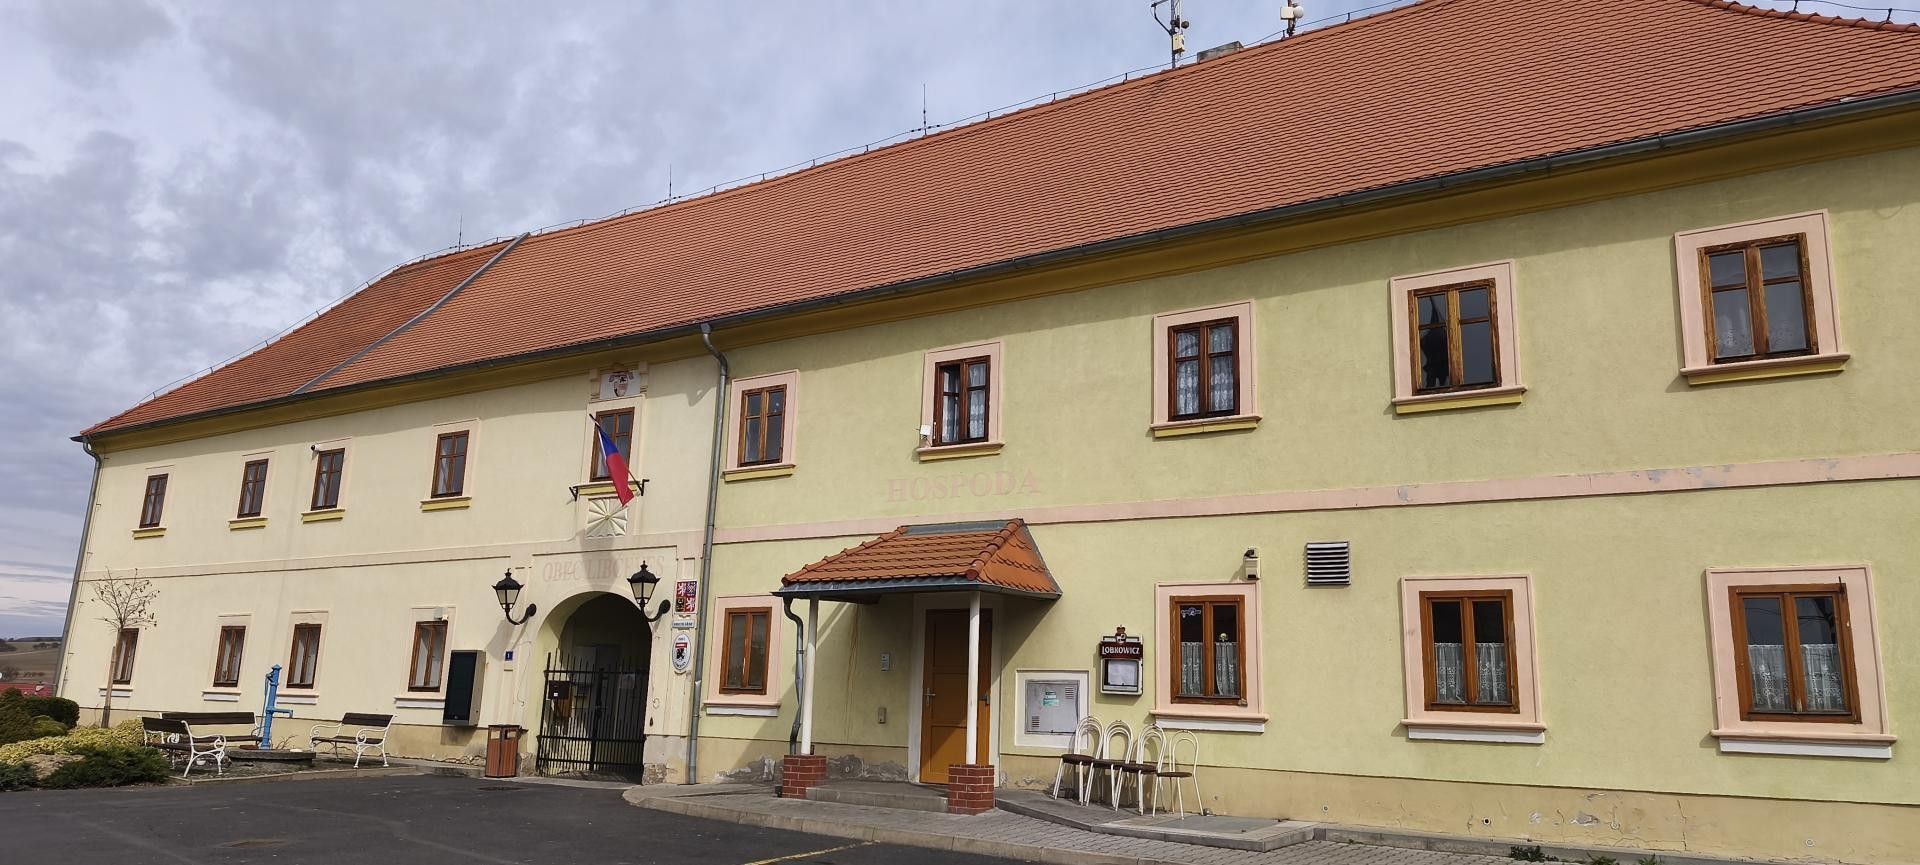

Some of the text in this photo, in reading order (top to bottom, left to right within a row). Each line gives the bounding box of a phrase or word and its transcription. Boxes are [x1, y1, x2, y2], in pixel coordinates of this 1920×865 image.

[887, 467, 1041, 502] HOSPODA
[543, 560, 581, 581] OBEC
[1101, 645, 1140, 655] LOBKOWICZ
